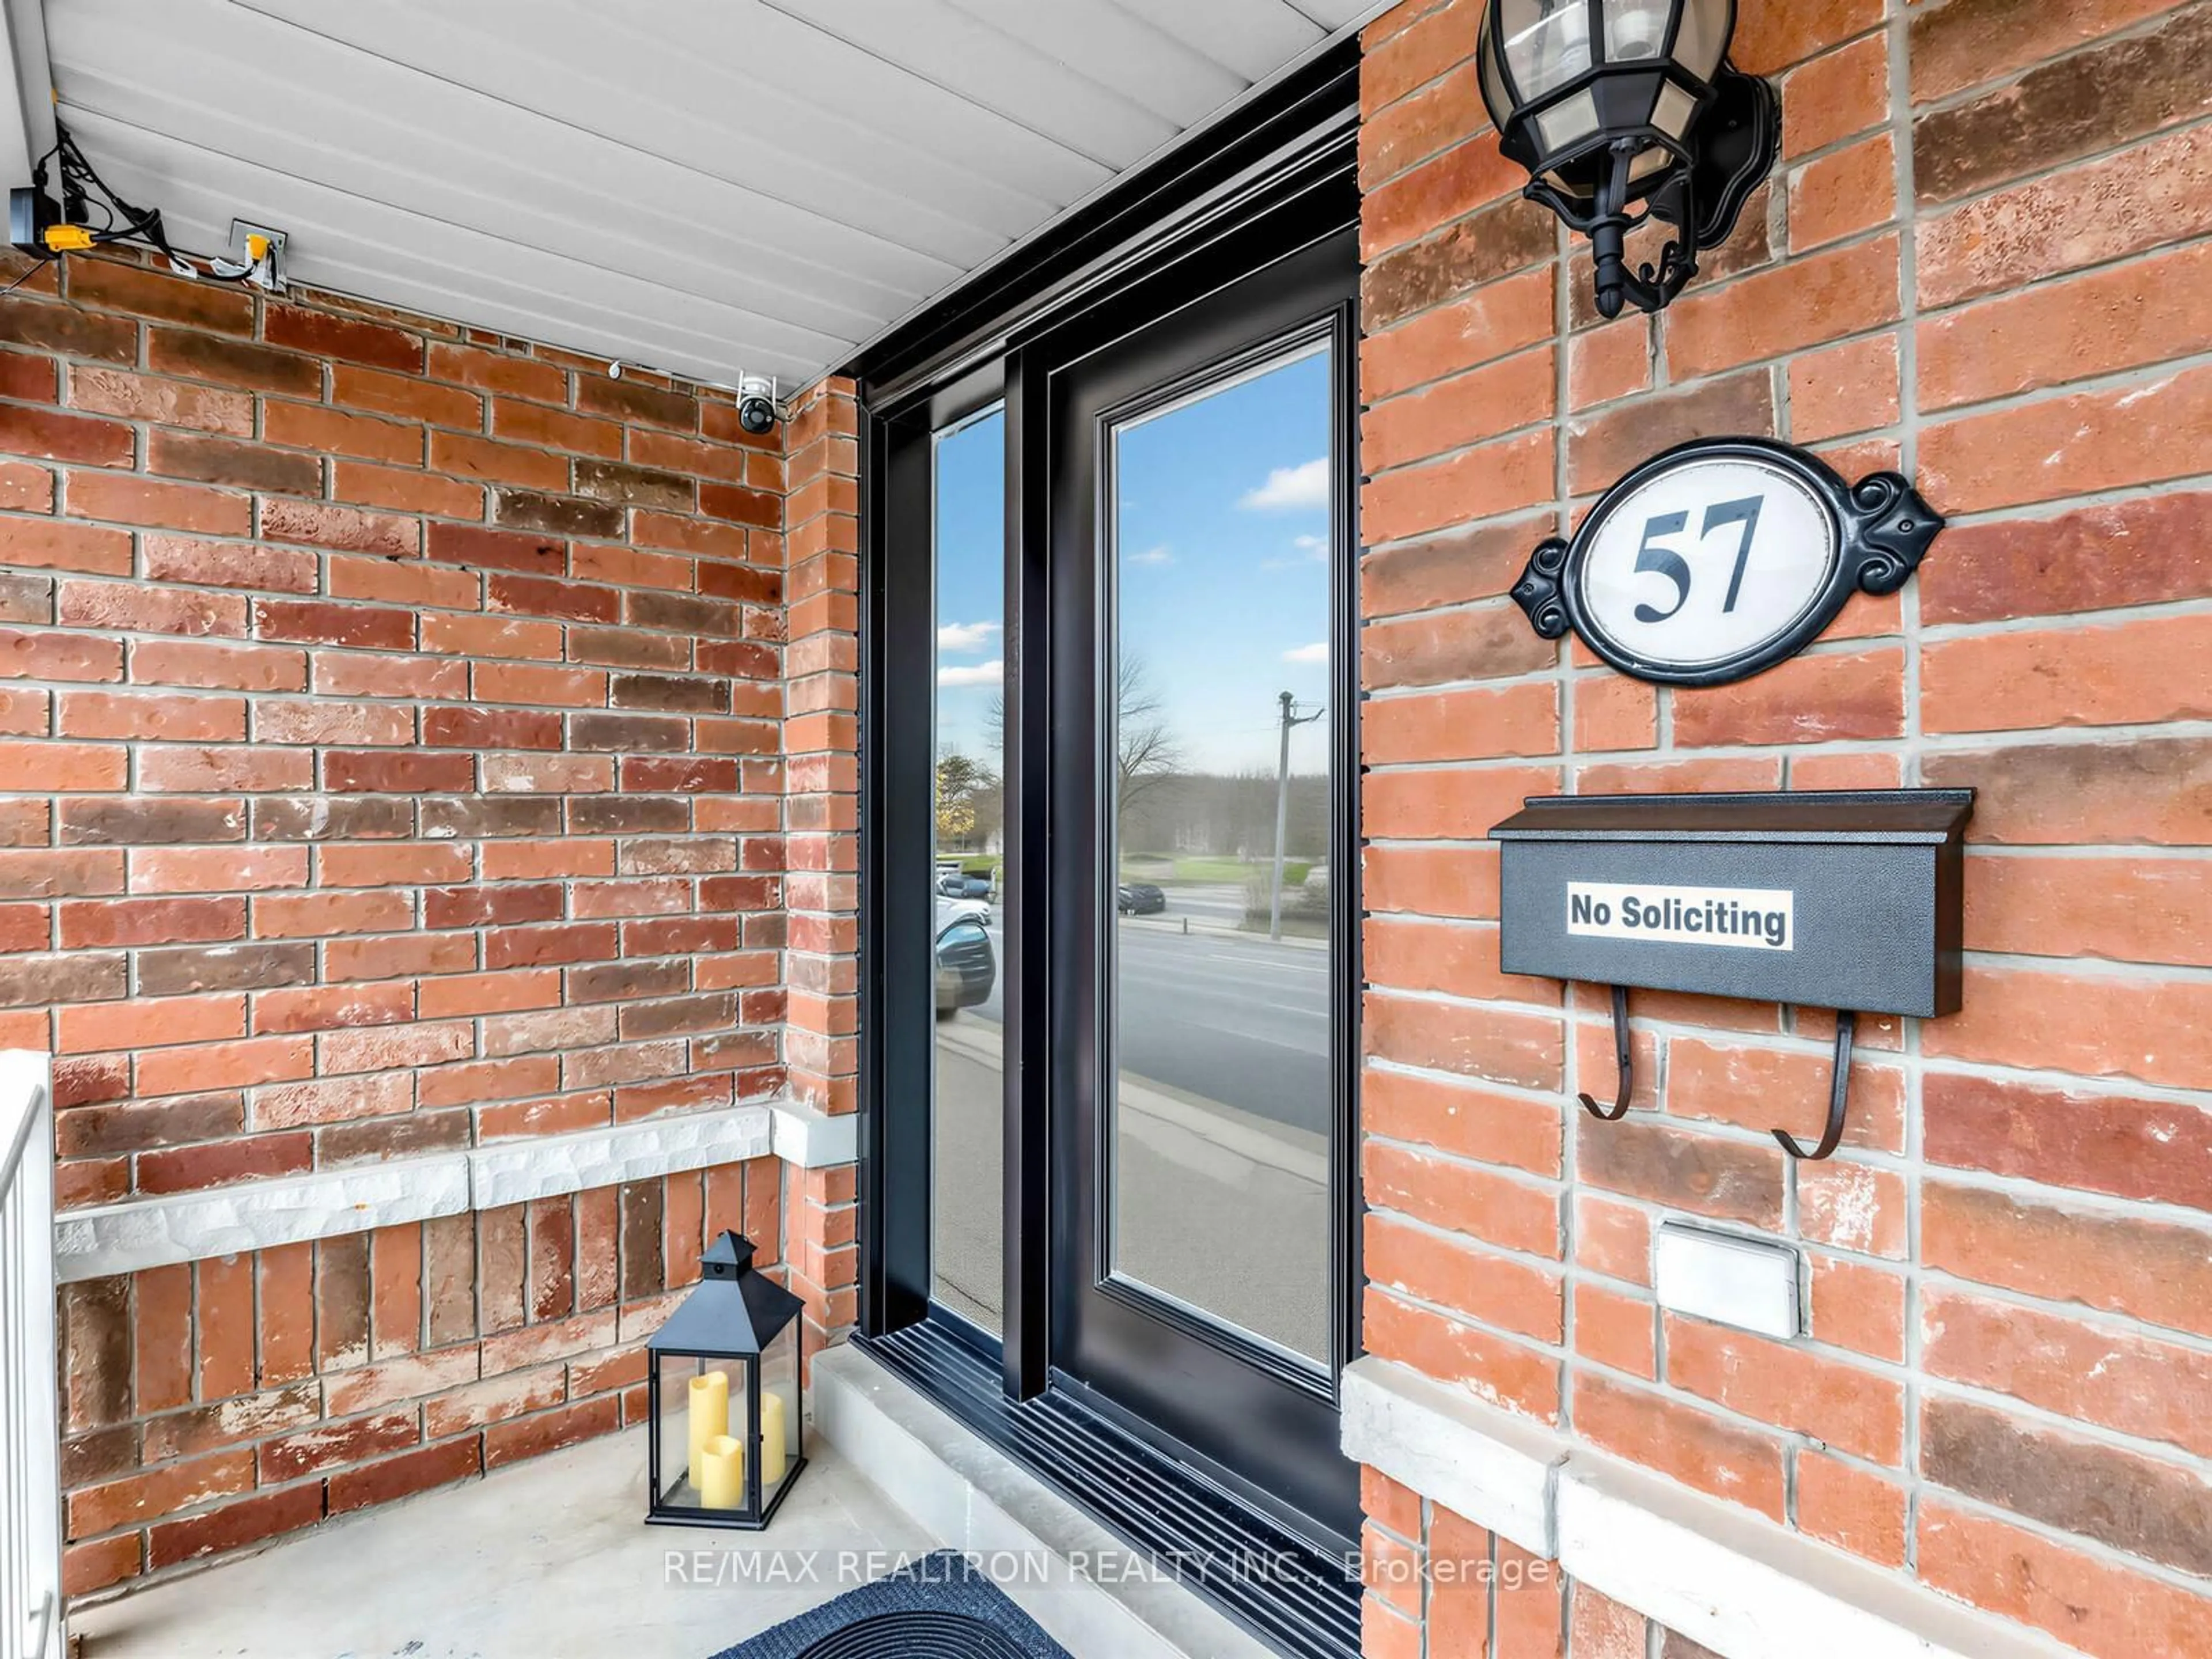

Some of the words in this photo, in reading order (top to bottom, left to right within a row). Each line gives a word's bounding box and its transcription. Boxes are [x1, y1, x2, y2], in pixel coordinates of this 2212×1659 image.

[1634, 494, 1764, 623] 57
[1571, 894, 1611, 925] No
[1622, 896, 1786, 946] Soliciting
